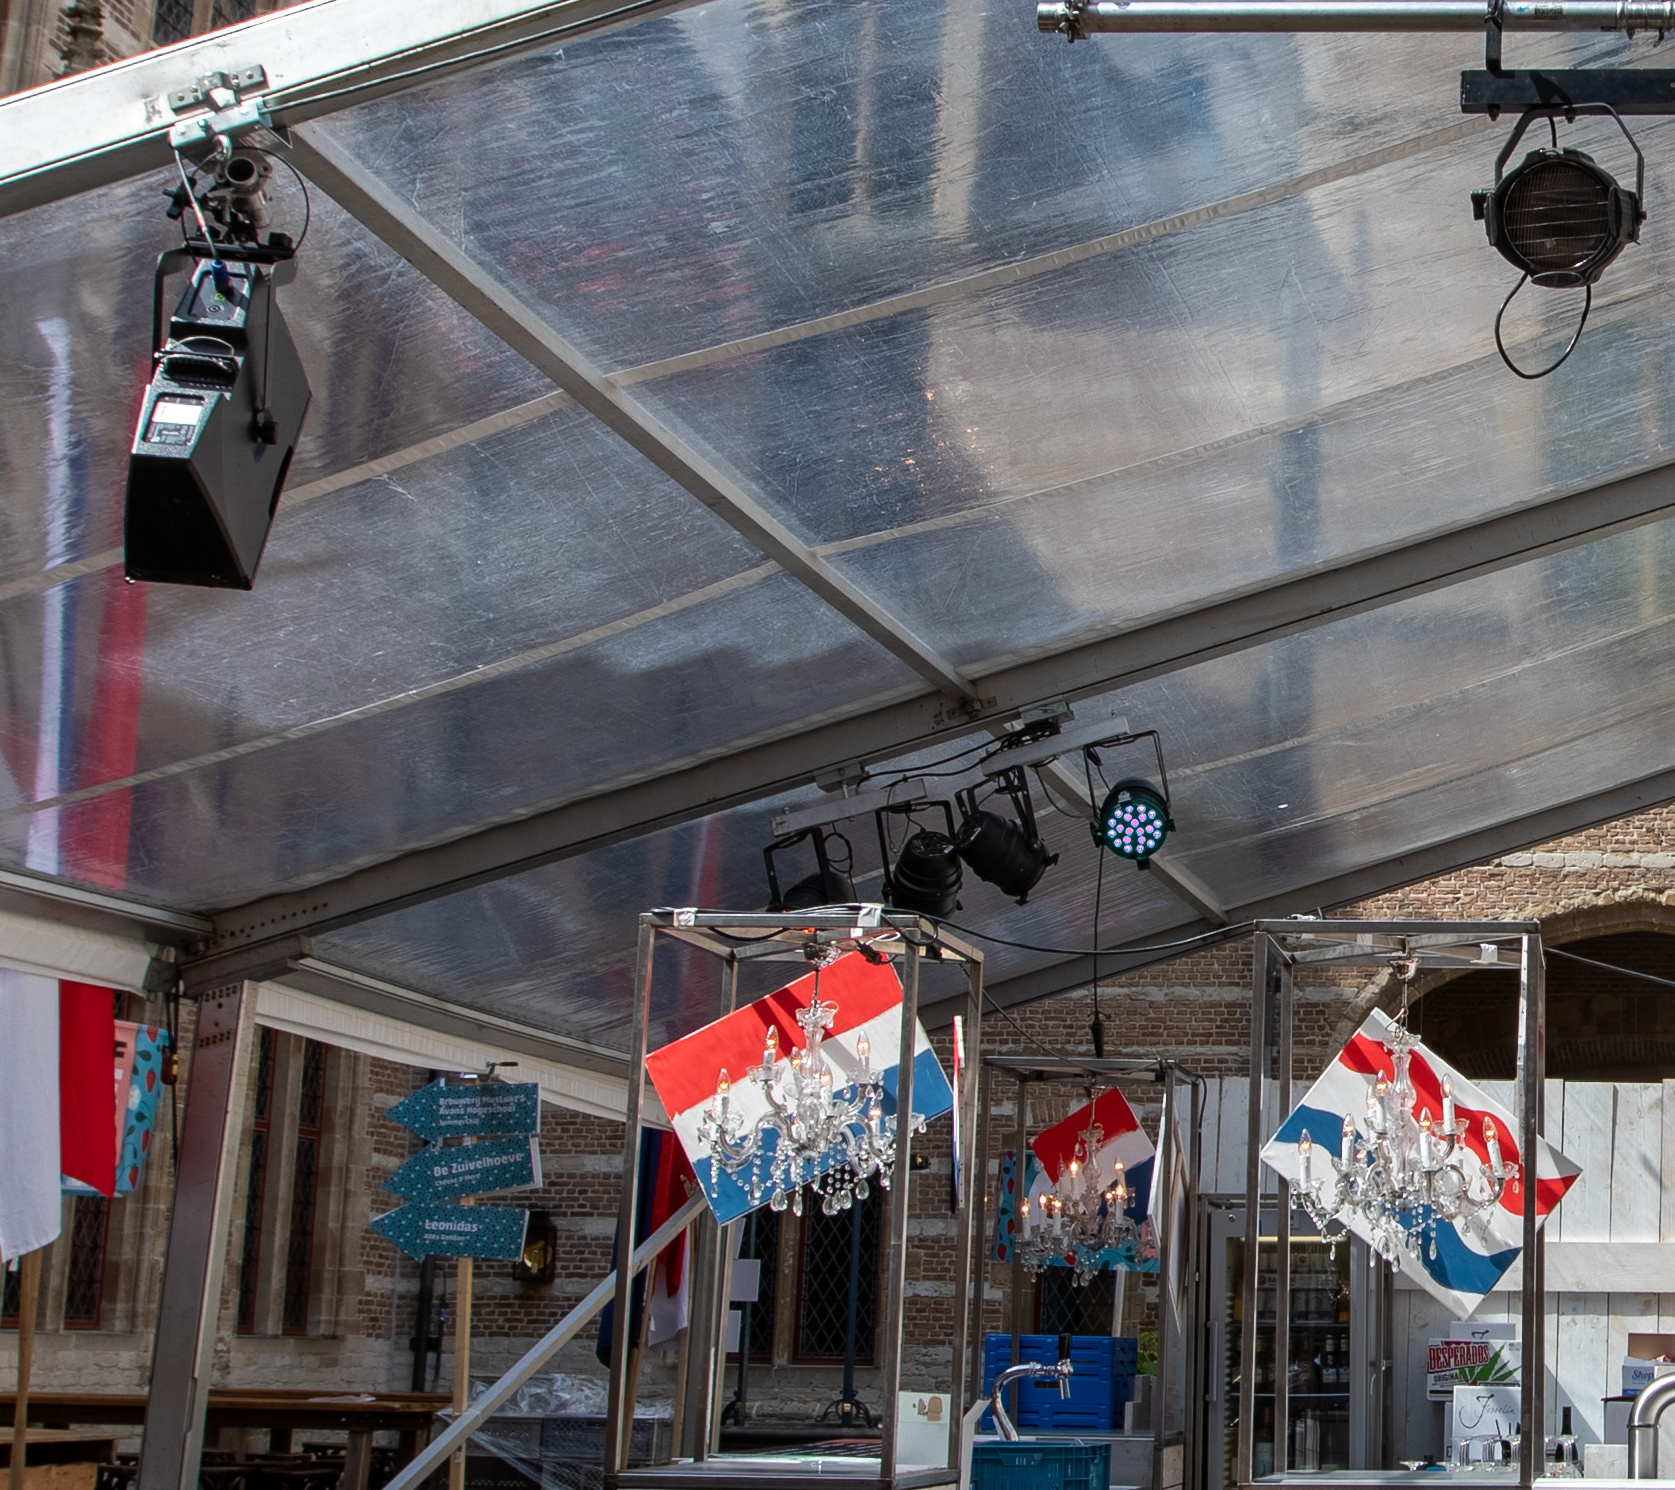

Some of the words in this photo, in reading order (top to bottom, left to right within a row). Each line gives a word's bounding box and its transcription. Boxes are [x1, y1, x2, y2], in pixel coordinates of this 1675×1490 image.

[439, 1107, 464, 1115] Avans
[466, 1105, 516, 1116] Hogeschool
[433, 1166, 448, 1177] De
[451, 1152, 523, 1174] Zuivelhoeve
[424, 1219, 478, 1232] Leonidas
[1428, 1343, 1490, 1371] DESPERADOS
